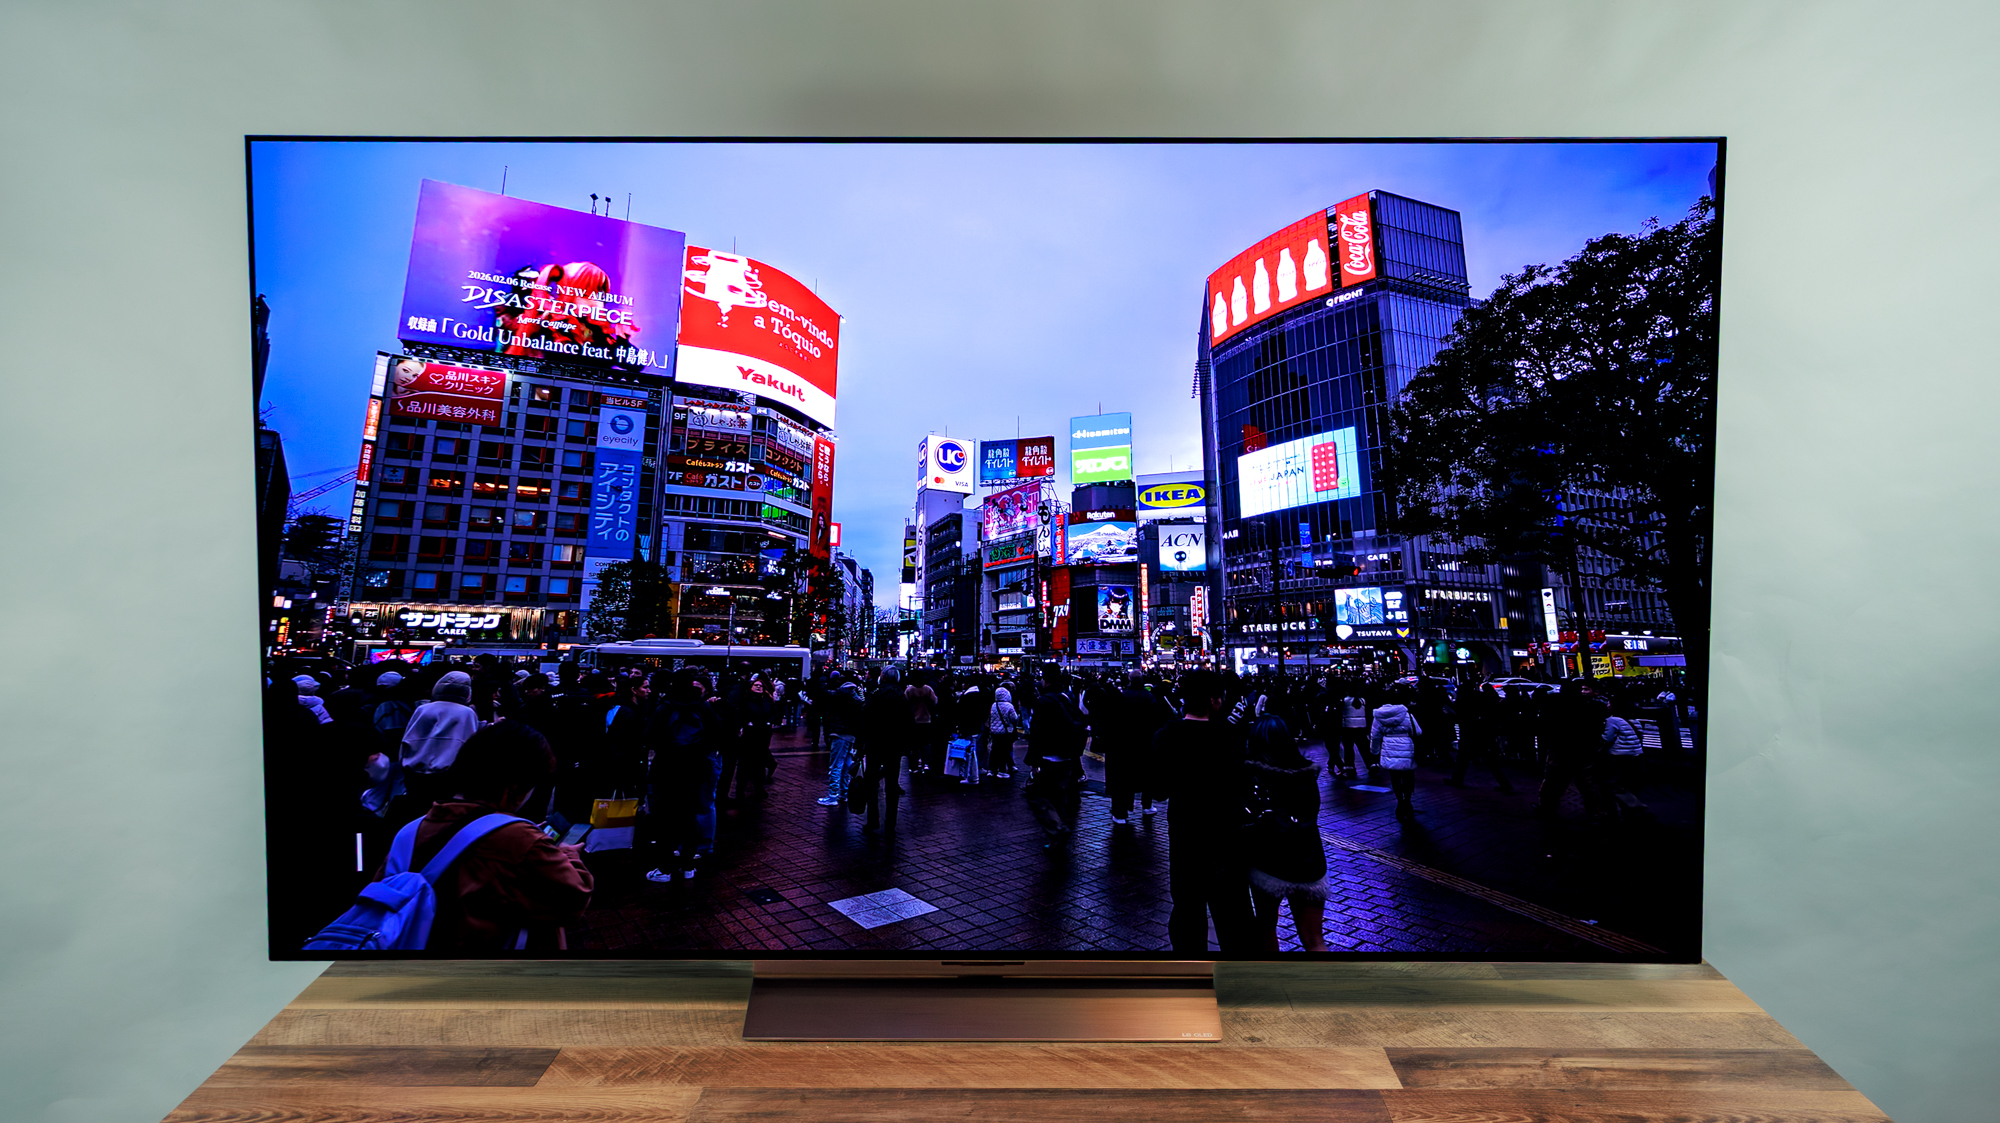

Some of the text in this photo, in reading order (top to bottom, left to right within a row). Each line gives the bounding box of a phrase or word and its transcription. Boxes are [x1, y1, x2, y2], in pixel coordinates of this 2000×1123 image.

[467, 270, 634, 307] 2026.02.06 Release NEW ALBUM
[461, 285, 634, 325] DISASTERPIECE
[498, 328, 580, 353] Unbalance
[582, 341, 613, 360] feat.
[754, 315, 766, 329] a
[770, 316, 821, 358] Tóquio
[445, 370, 501, 385] 品川スキン
[736, 365, 806, 402] Yakult
[444, 382, 495, 395] クリニック
[406, 400, 496, 422] 品川美容外科
[673, 412, 687, 421] 9F
[603, 435, 639, 447] eyecity
[724, 460, 755, 474] ガスト
[1270, 465, 1304, 481] JAPAN
[668, 471, 684, 482] 7F
[704, 472, 742, 489] ガスト
[955, 480, 969, 488] VISA
[594, 461, 619, 542] アイシティ
[614, 463, 635, 543] コンタクトの
[1145, 488, 1202, 503] IKEA
[1086, 511, 1117, 521] Rakuten
[1161, 533, 1204, 547] ACN
[1424, 589, 1490, 602] STARBUCKS
[400, 612, 501, 629] サンドラッグ
[1079, 641, 1131, 651] 大盛堂店
